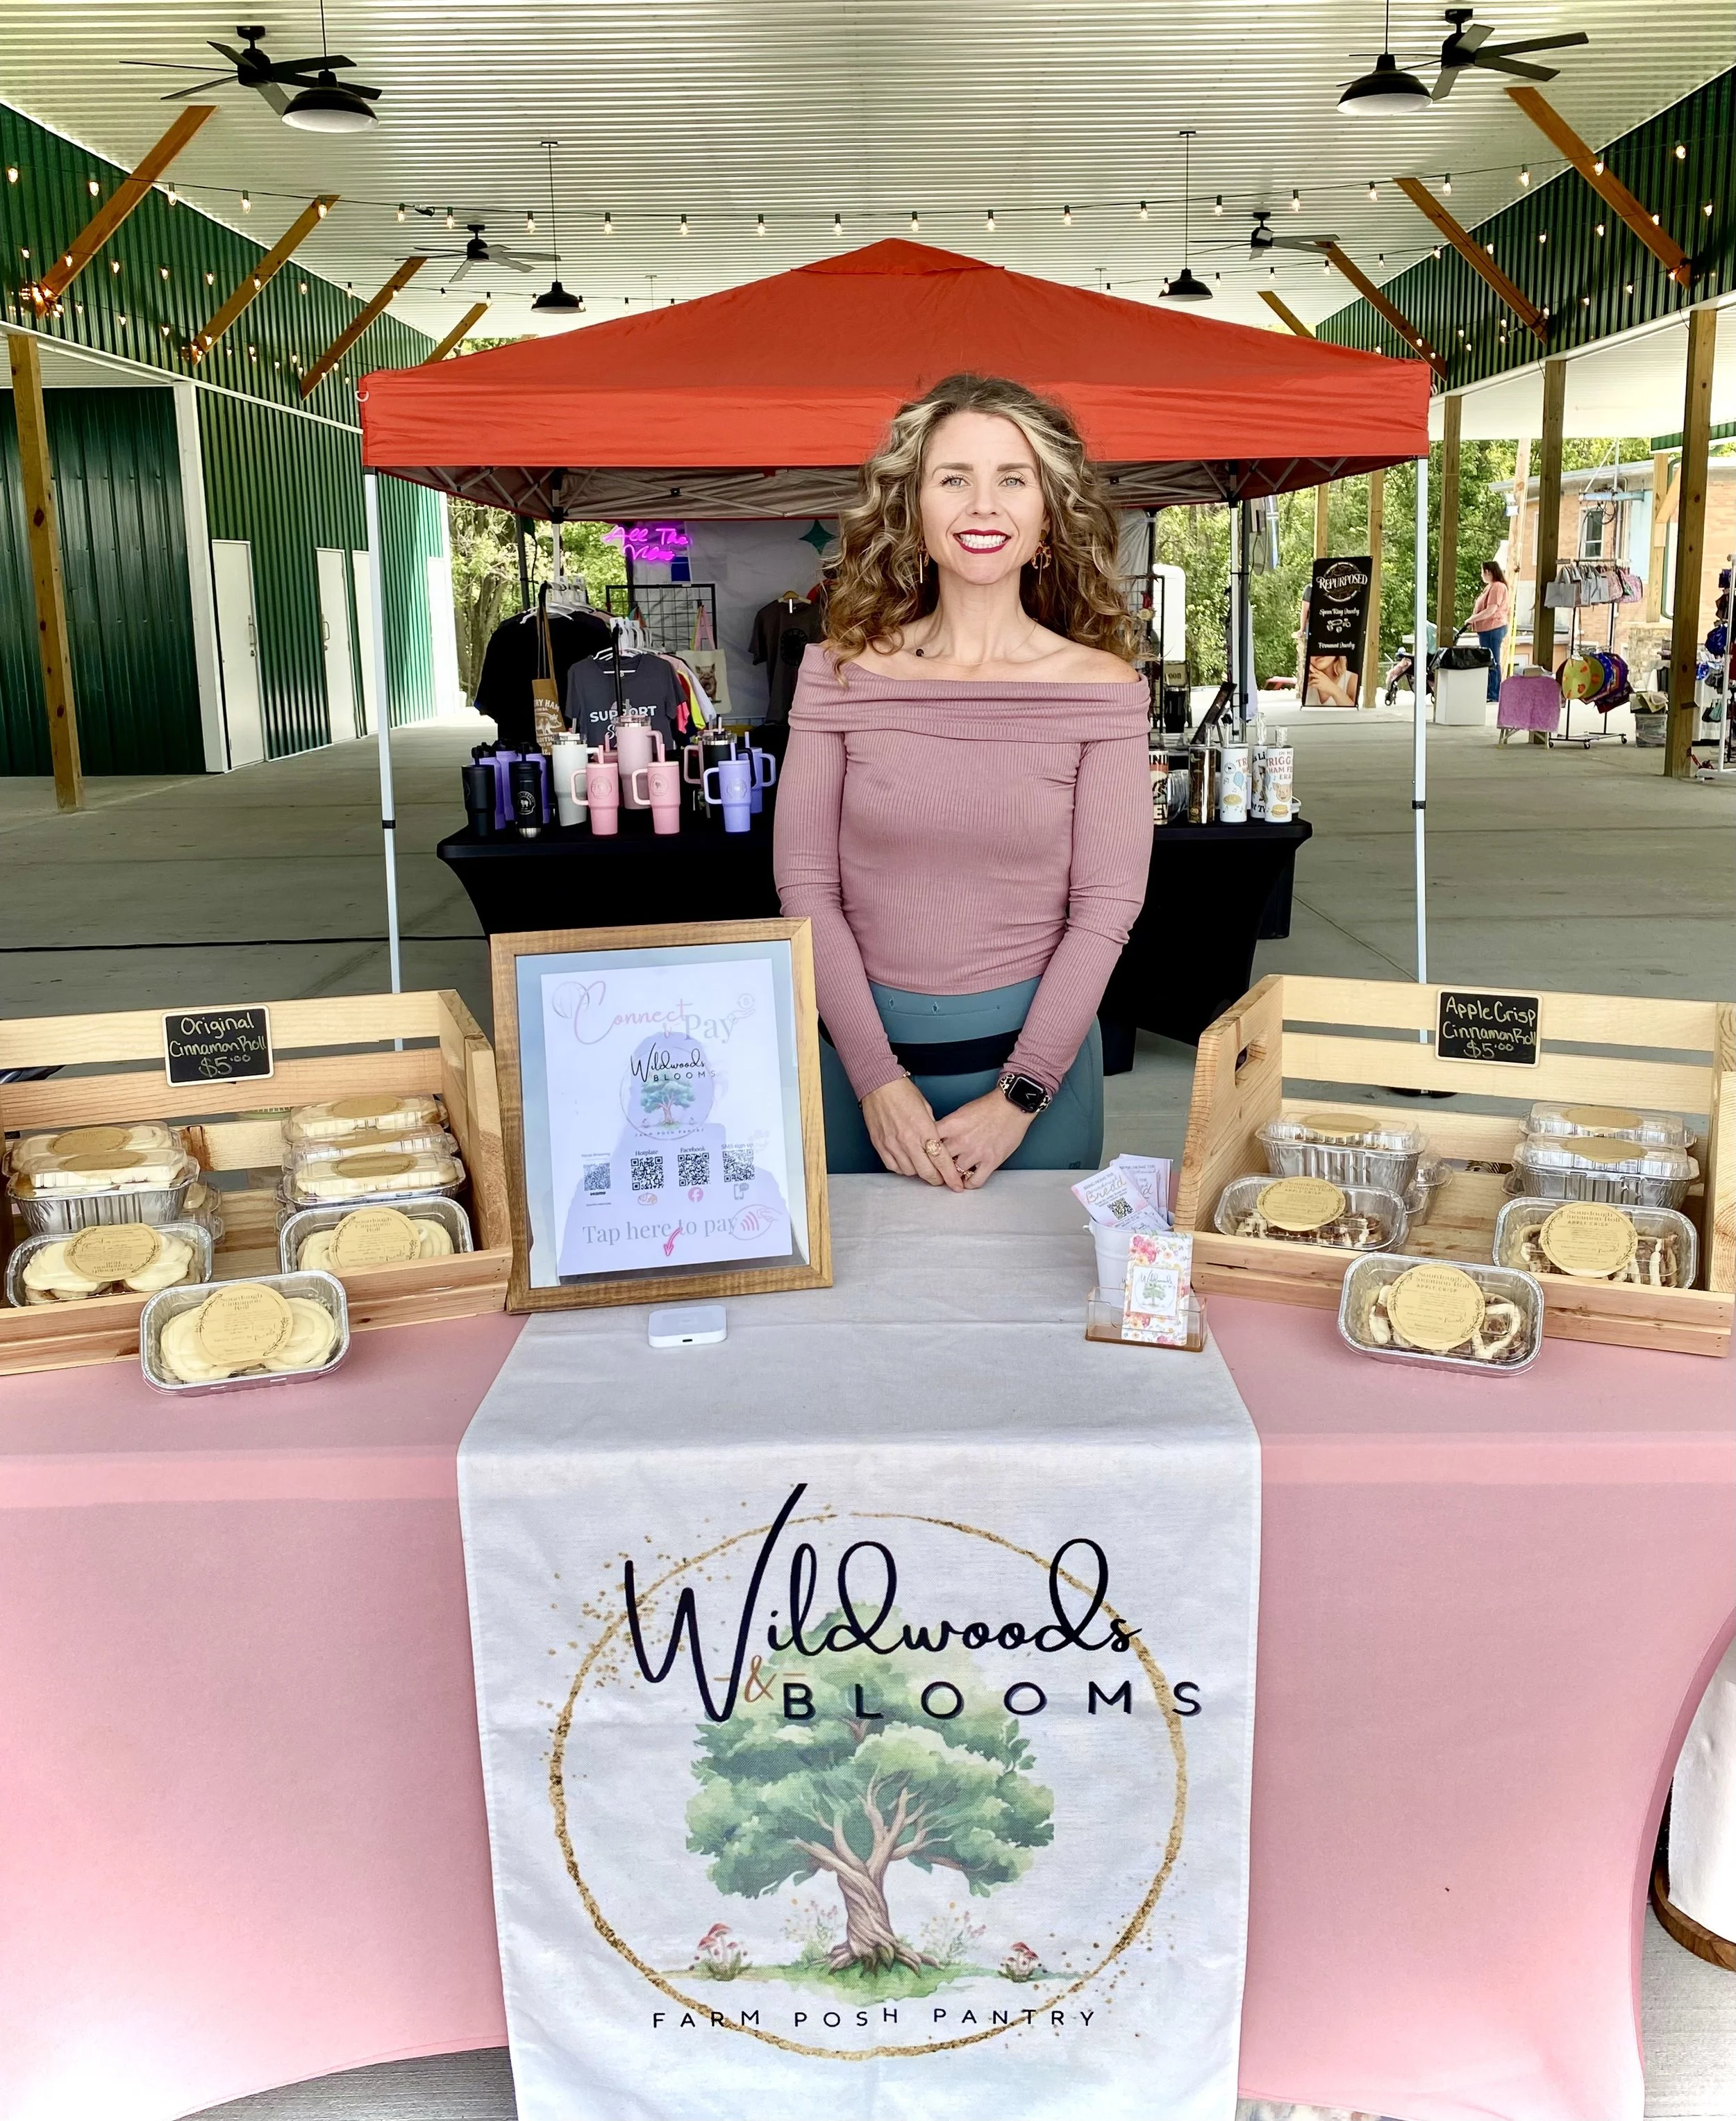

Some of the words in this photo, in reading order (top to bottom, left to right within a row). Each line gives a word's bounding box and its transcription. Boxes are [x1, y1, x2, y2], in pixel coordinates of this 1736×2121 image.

[1316, 573, 1368, 592] REPURPOSED
[590, 706, 657, 723] SUPORT
[181, 1012, 254, 1039] Original
[574, 980, 693, 1045] Connect
[1445, 995, 1493, 1020] Apple
[1494, 1000, 1537, 1027] Crisp
[684, 1013, 735, 1045] Pay
[630, 1042, 705, 1083] Wildwoods
[653, 1070, 716, 1082] BLOOMS
[583, 1224, 620, 1245] Tap
[626, 1221, 671, 1241] here
[678, 1219, 697, 1235] to
[704, 1216, 737, 1237] pay
[624, 1482, 1143, 1723] Wildwoods
[783, 1679, 1203, 1720] BLOOMS
[652, 2008, 761, 2028] FARM
[794, 2006, 898, 2027] POSH
[933, 2007, 1096, 2027] PANTRY
